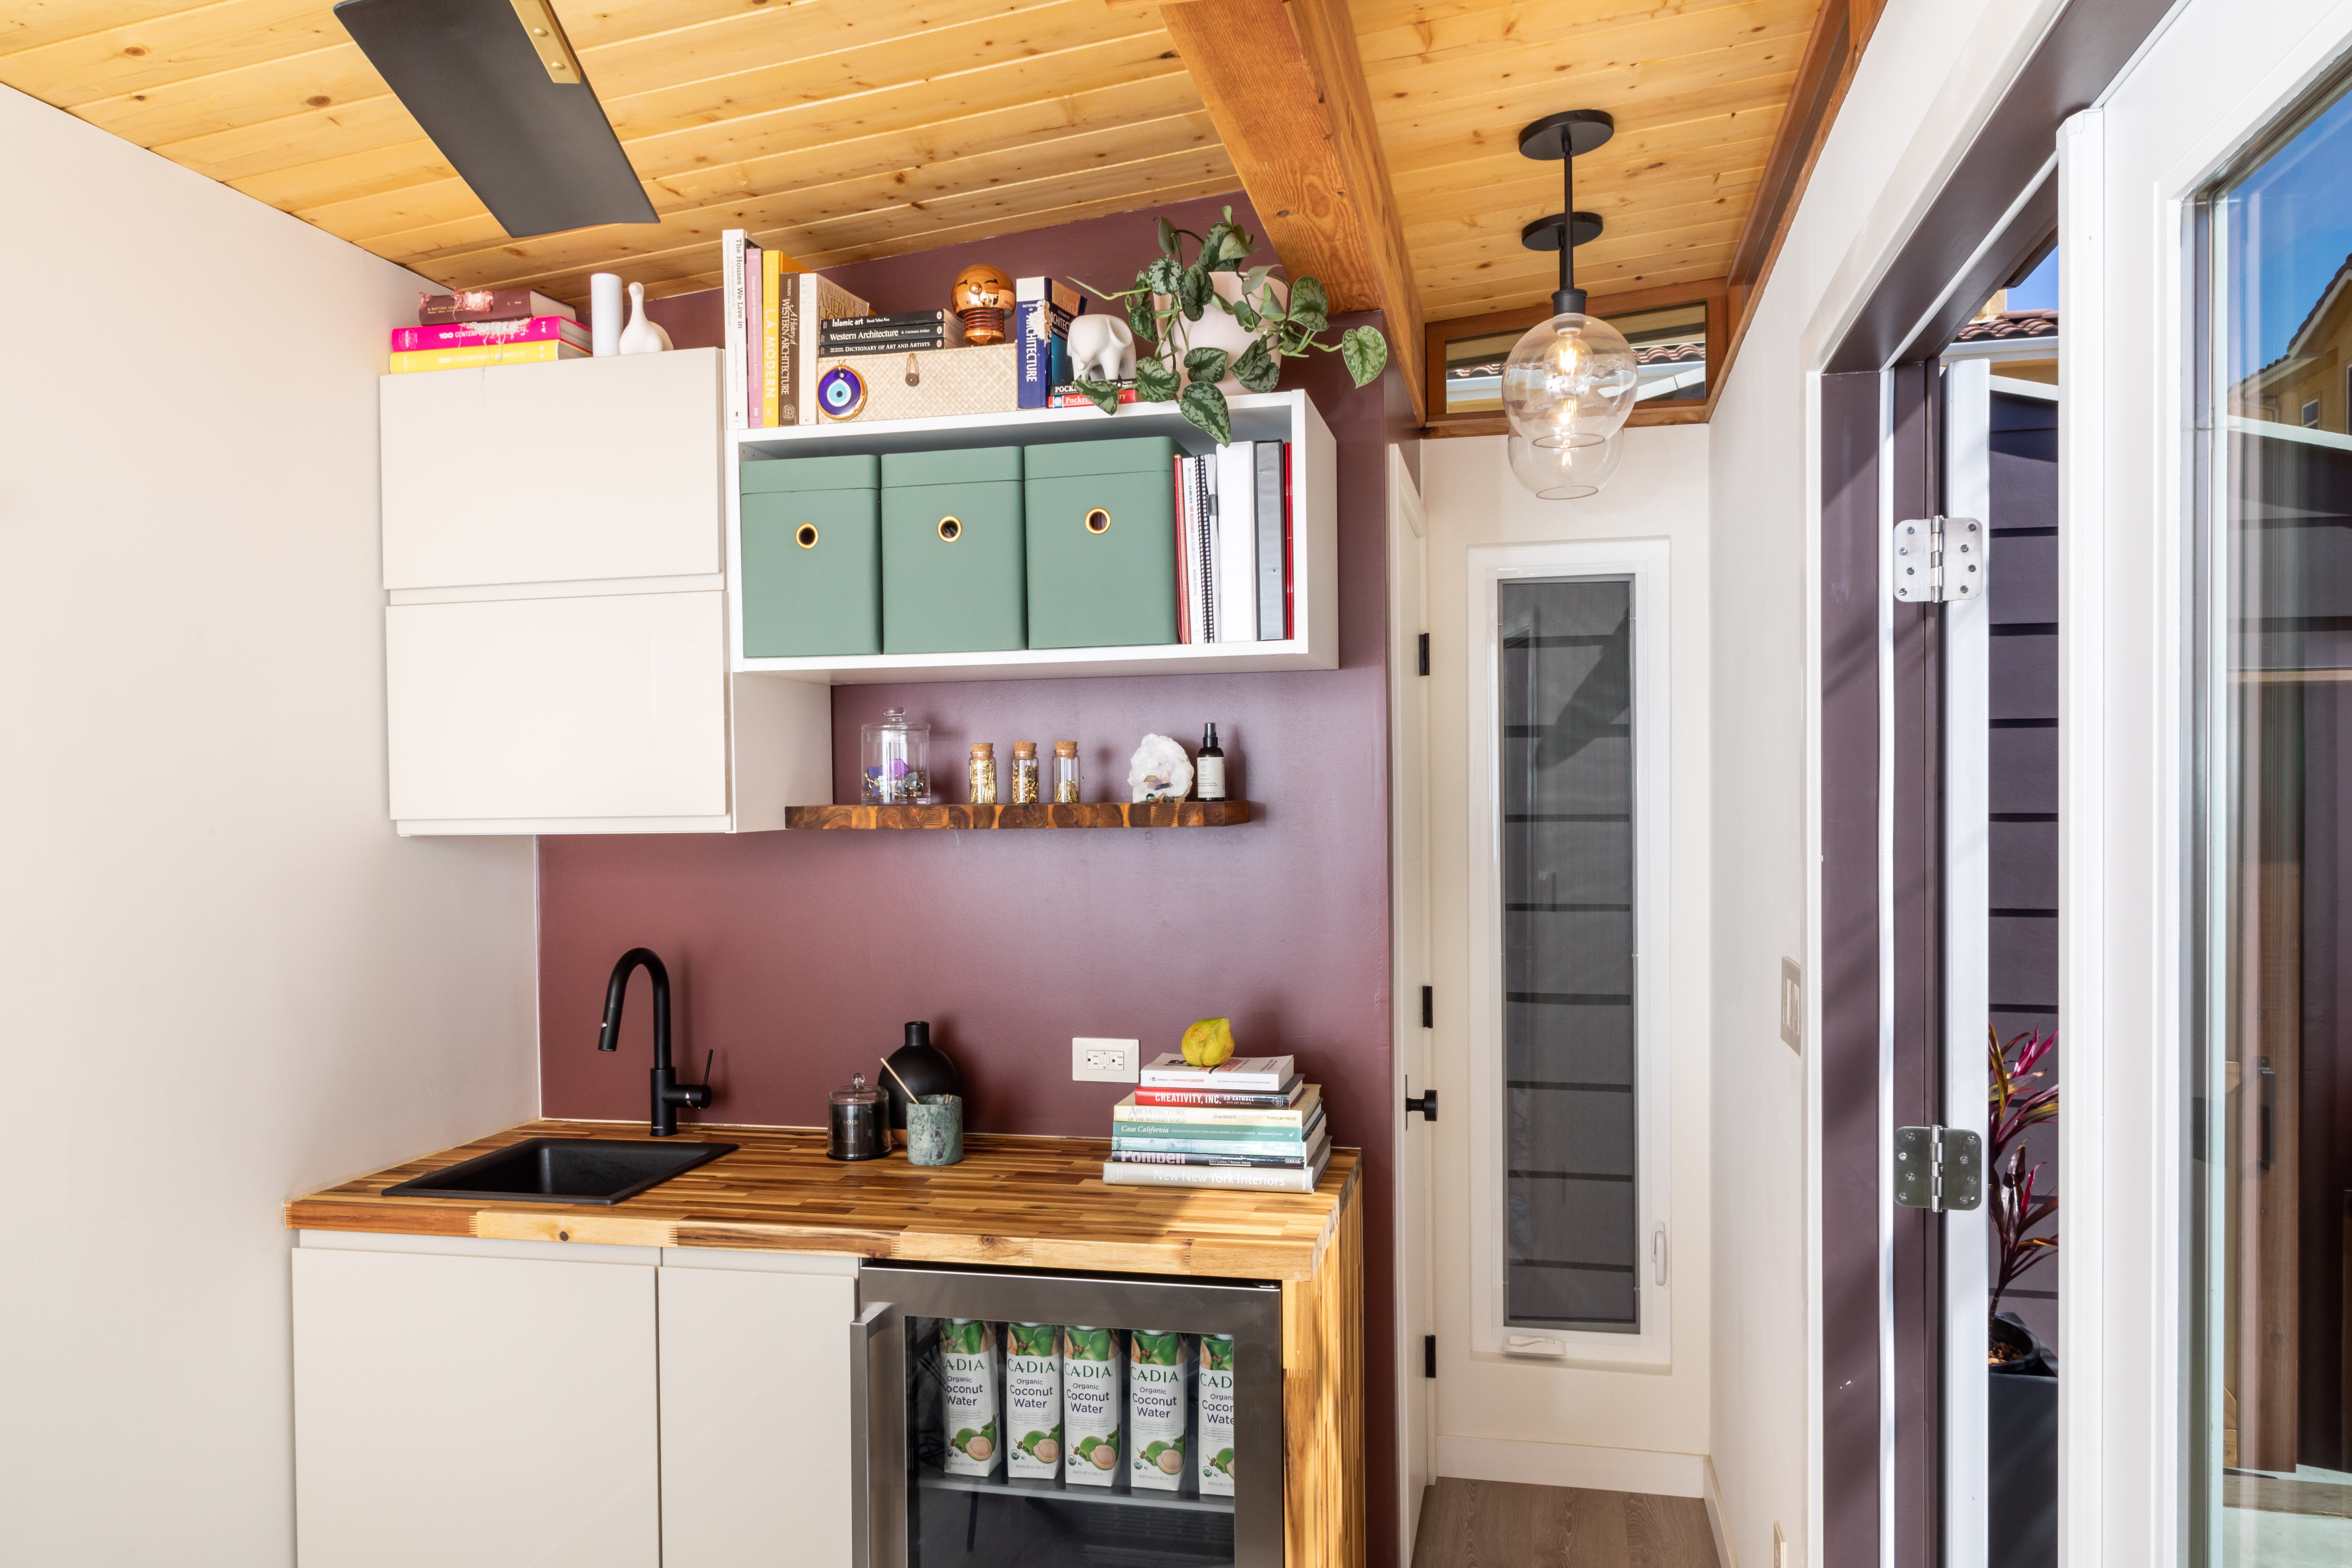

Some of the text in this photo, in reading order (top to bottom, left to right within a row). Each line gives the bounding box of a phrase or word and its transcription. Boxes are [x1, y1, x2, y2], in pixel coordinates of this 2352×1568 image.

[737, 288, 743, 300] We
[819, 280, 867, 314] A FIELD GUIDE TO
[1053, 288, 1078, 315] Oxford
[789, 319, 797, 339] History
[832, 319, 853, 327] Islamic
[858, 330, 899, 339] Architecture
[766, 309, 776, 397] L.A. MODERN
[781, 337, 790, 395] ARCHITECTURE
[1155, 1093, 1203, 1104] CREATIVITY,
[1205, 1094, 1222, 1104] INC.
[1129, 1106, 1186, 1116] ARCHITECTURE
[1138, 1126, 1169, 1134] California
[1154, 1170, 1179, 1180] New
[1182, 1171, 1207, 1182] New
[1209, 1172, 1234, 1183] York
[1237, 1173, 1285, 1186] Interiors
[942, 1359, 984, 1371] ADIA
[1008, 1359, 1055, 1373] CADIA
[1064, 1363, 1111, 1378] CADIA
[1131, 1366, 1178, 1383] CADIA
[1200, 1373, 1232, 1388] CAD
[1010, 1384, 1053, 1396] Coconut
[1067, 1389, 1109, 1401] Coconut
[946, 1395, 977, 1406] Water
[1014, 1397, 1047, 1408] Water
[1133, 1393, 1177, 1406] Coconut
[1071, 1402, 1103, 1413] Water
[1137, 1406, 1170, 1418] Water
